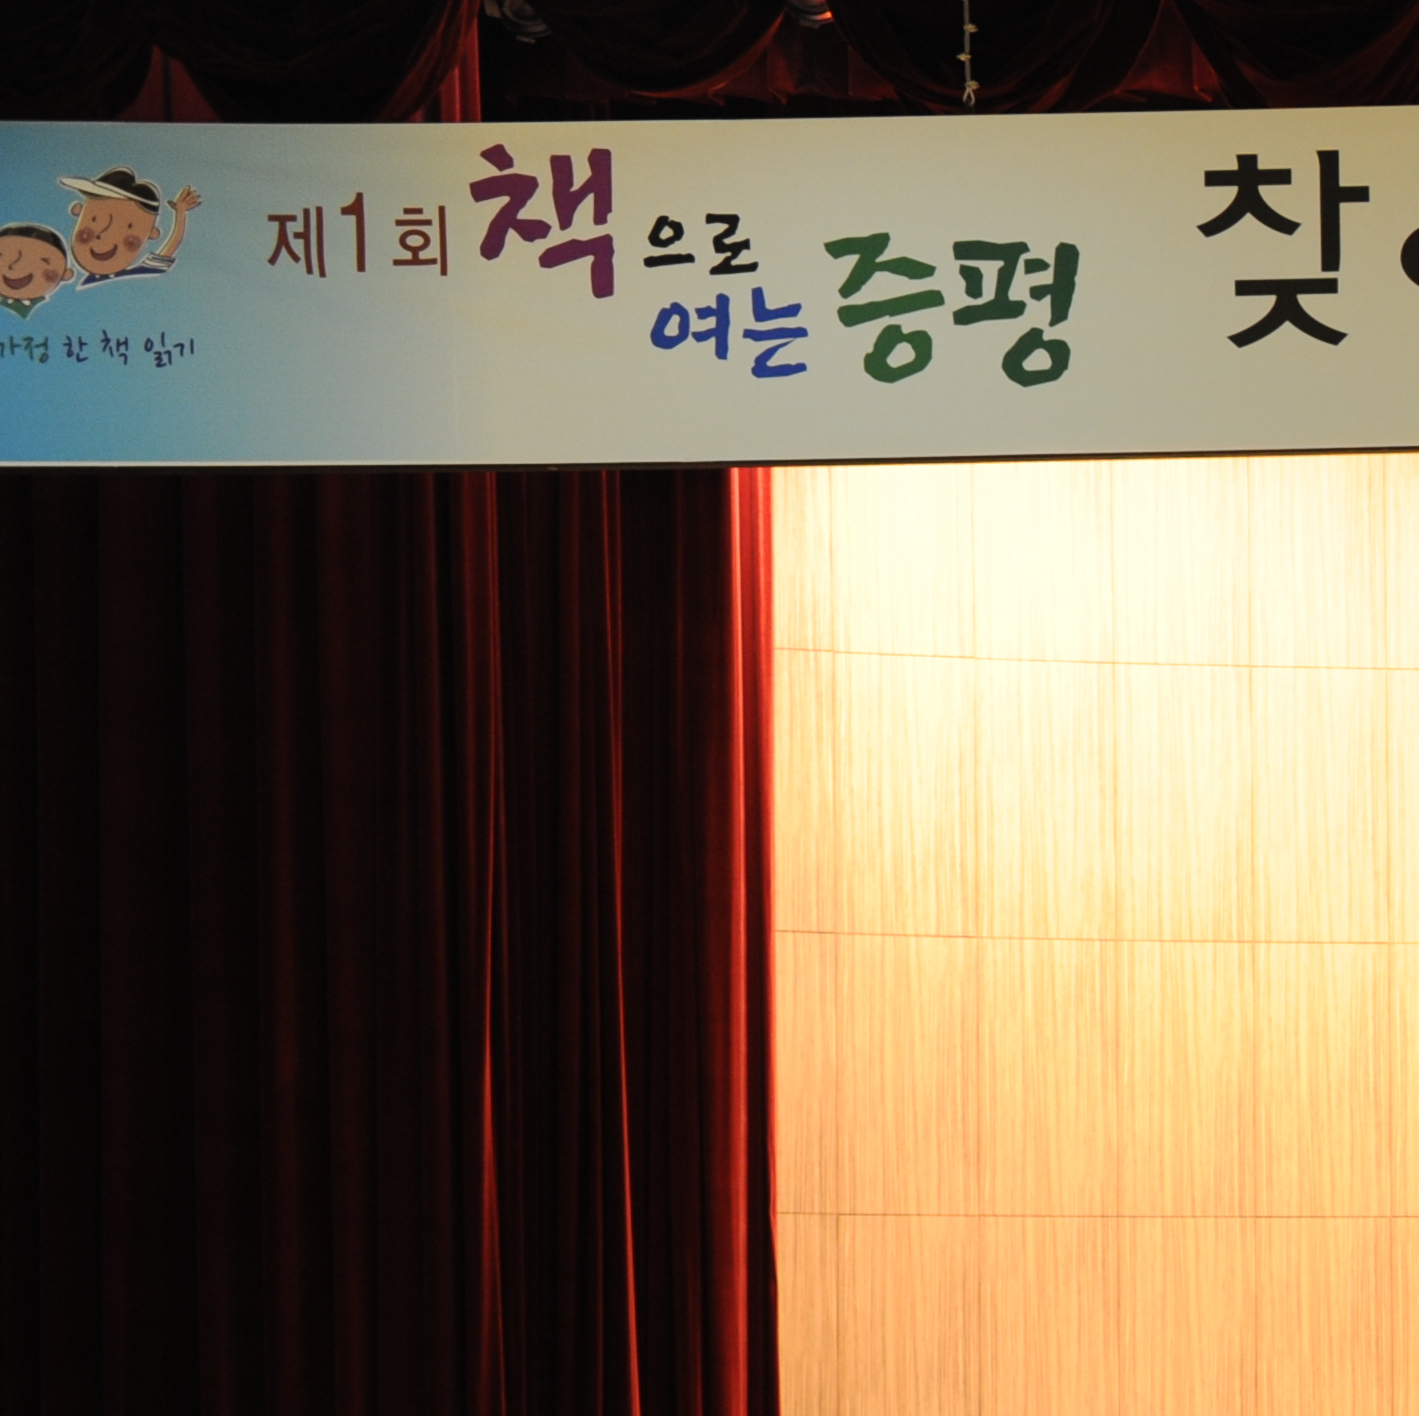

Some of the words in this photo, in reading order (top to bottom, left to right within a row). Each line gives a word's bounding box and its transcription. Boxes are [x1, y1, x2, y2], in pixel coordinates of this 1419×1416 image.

[63, 335, 89, 363] 한
[100, 329, 129, 366] 책
[144, 331, 195, 368] 읽기
[267, 192, 448, 278] 제1회
[650, 286, 809, 379] 여는
[823, 231, 1080, 388] 증평
